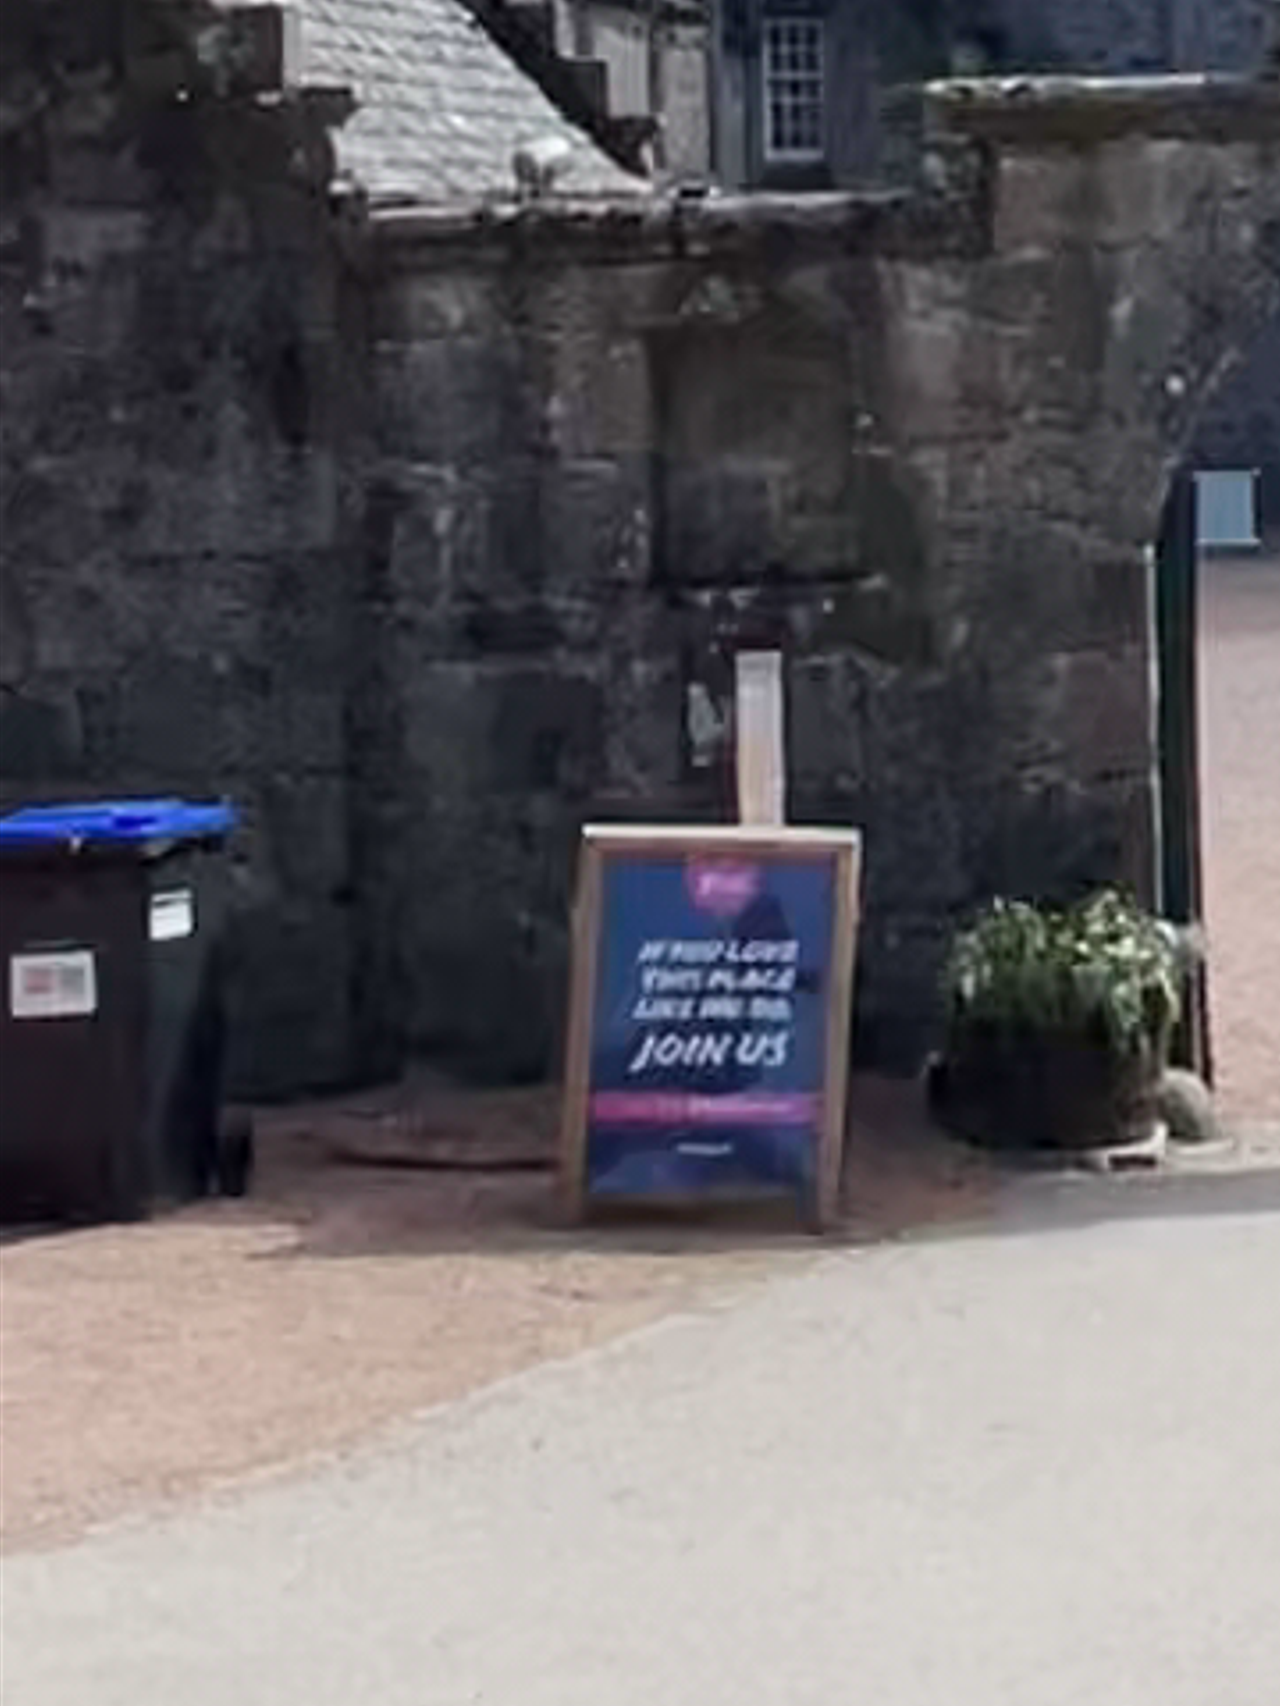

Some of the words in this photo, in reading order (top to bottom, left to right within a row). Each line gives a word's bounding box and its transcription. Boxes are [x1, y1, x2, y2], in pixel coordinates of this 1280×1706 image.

[708, 968, 797, 991] PLACE
[628, 1033, 733, 1073] JOIN
[735, 1032, 789, 1066] US
